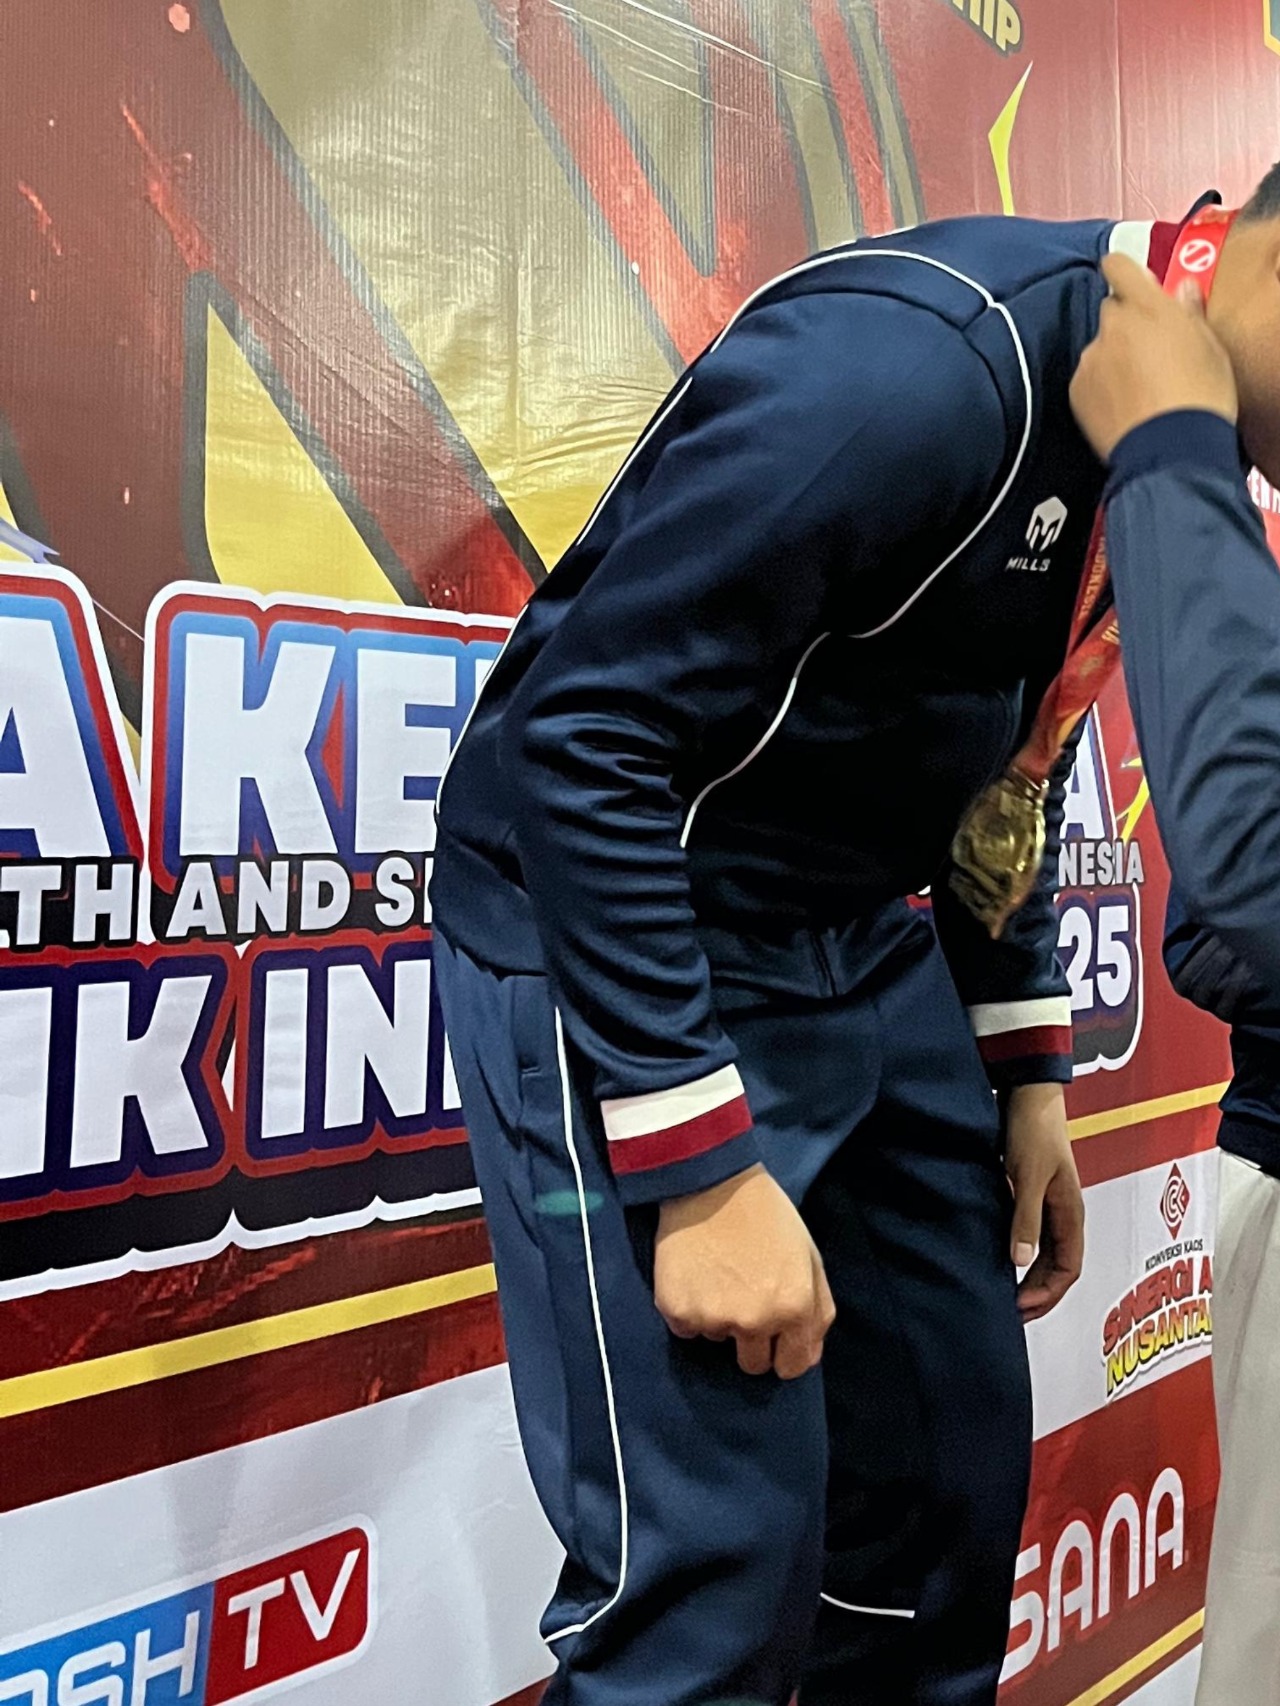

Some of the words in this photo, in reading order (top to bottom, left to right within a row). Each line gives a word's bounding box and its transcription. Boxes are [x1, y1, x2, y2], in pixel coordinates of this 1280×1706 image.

[1004, 556, 1051, 573] MILLS
[179, 631, 496, 857] KE
[0, 863, 134, 948] TH
[165, 858, 352, 938] AND
[374, 856, 435, 927] S
[1056, 904, 1132, 1011] 25
[261, 958, 464, 1139] IN
[1103, 1255, 1194, 1357] SINERGI
[1199, 1254, 1214, 1298] A
[1145, 1242, 1182, 1272] KONVEKSI
[1105, 1296, 1213, 1397] NUSANTA
[227, 1547, 361, 1671] TV
